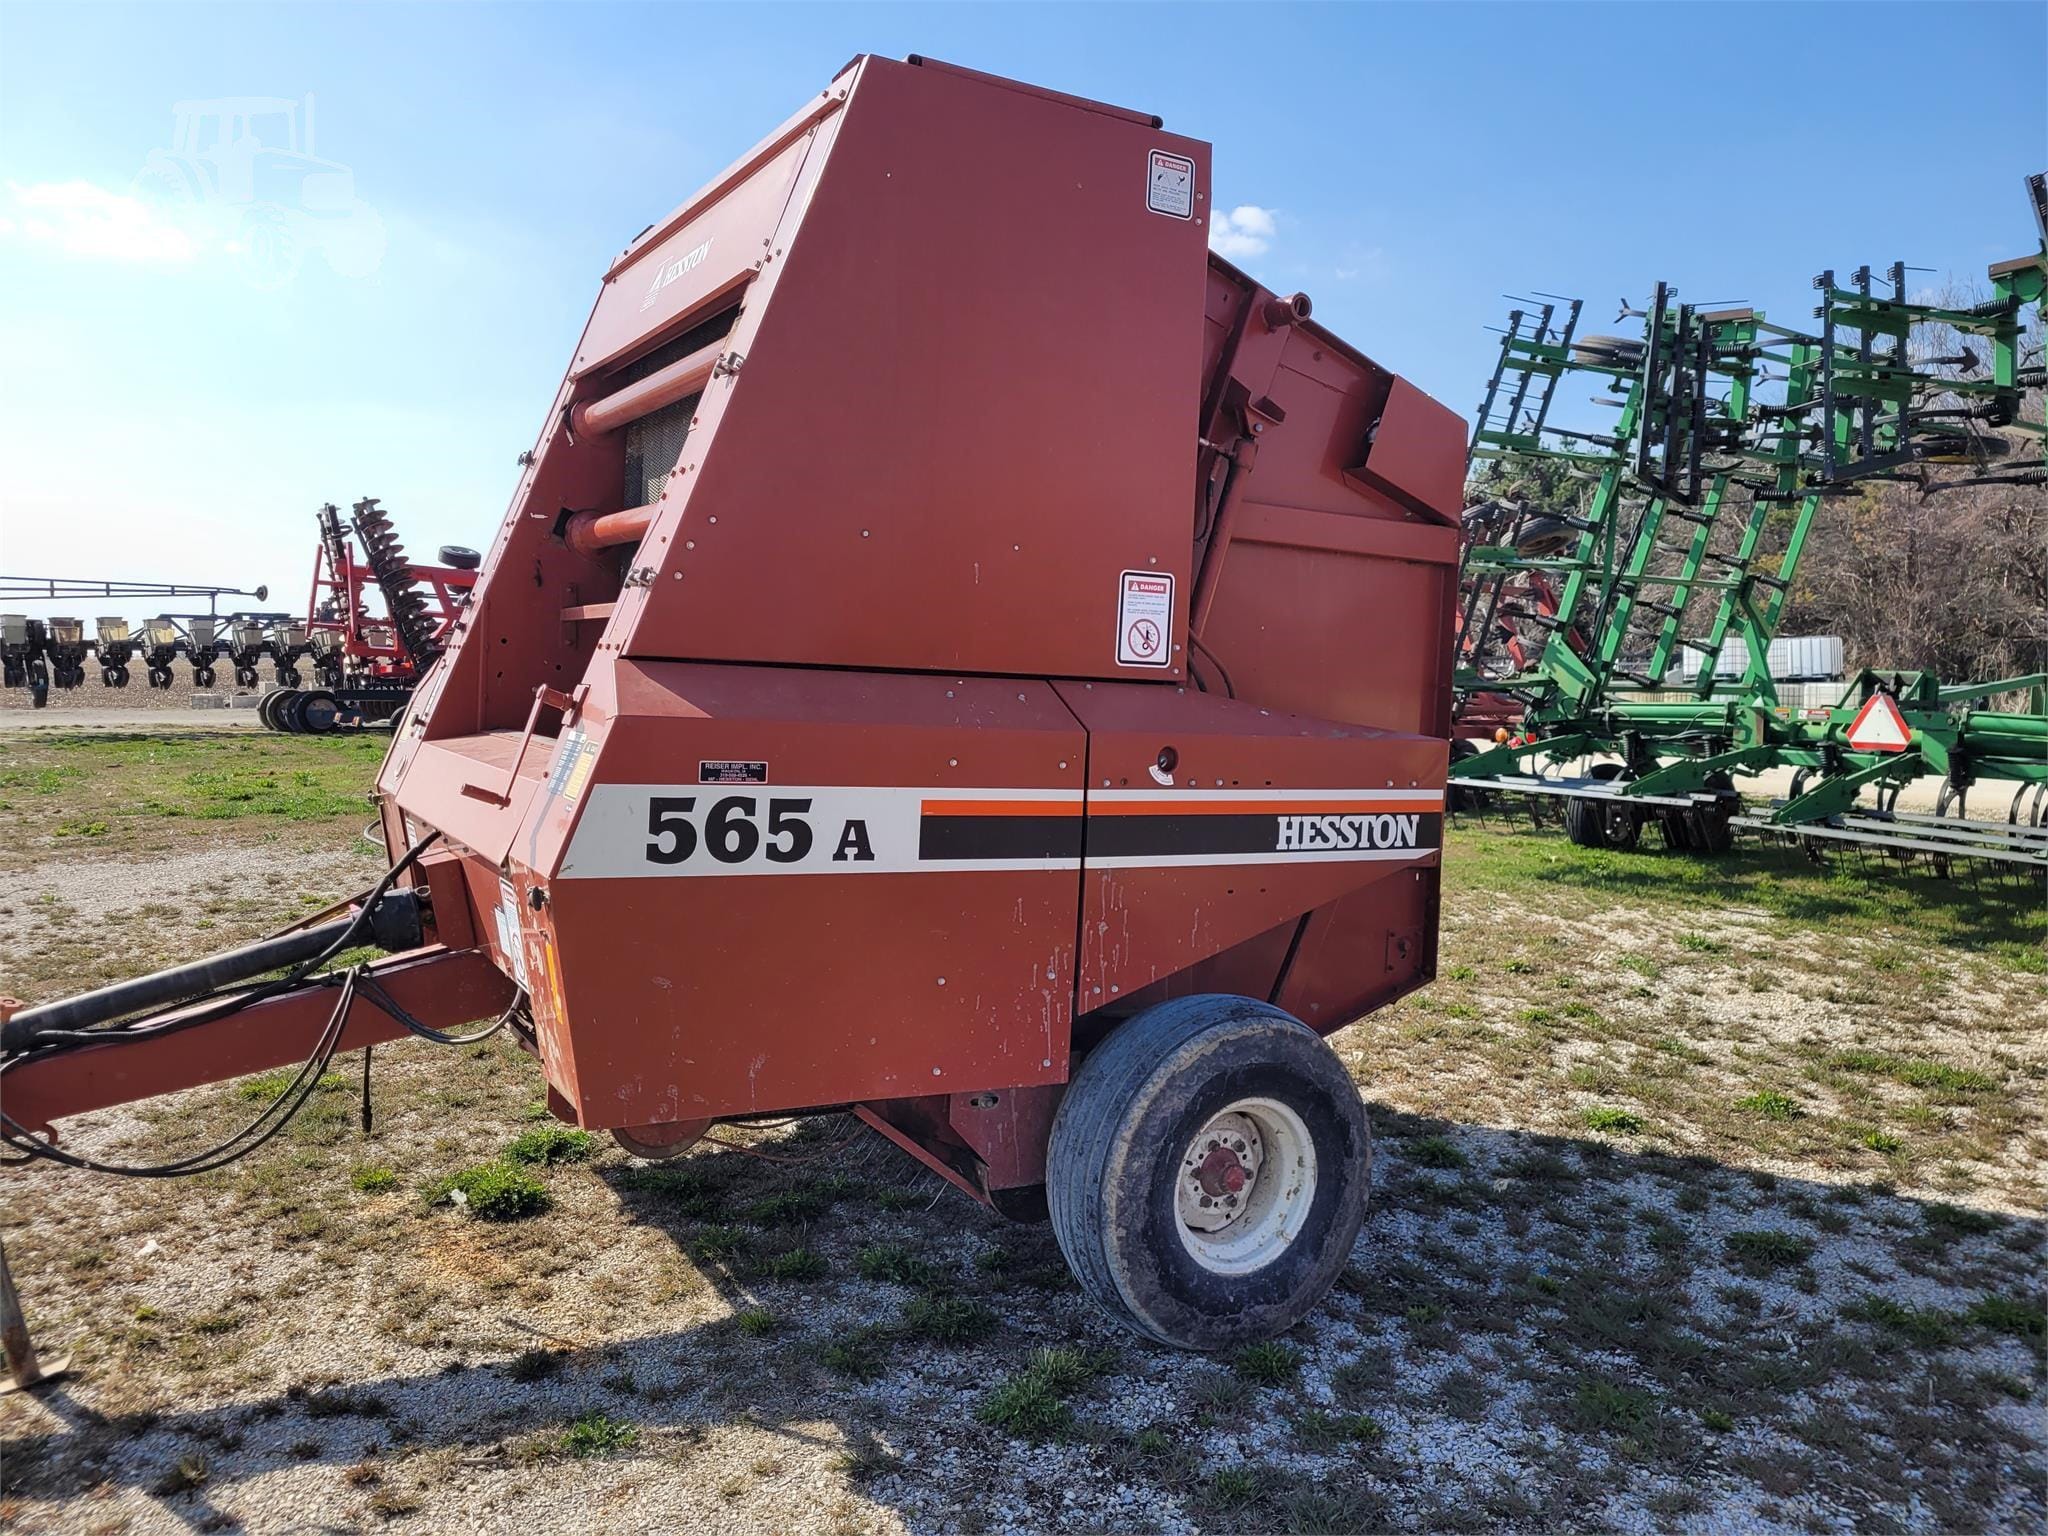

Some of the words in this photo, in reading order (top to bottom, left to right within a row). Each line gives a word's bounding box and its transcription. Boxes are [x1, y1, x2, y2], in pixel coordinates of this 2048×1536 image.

[1164, 161, 1187, 172] DANGER
[1140, 583, 1164, 592] DANGER
[646, 795, 813, 865] 565
[832, 819, 875, 861] A
[1276, 814, 1420, 850] HESSTON
